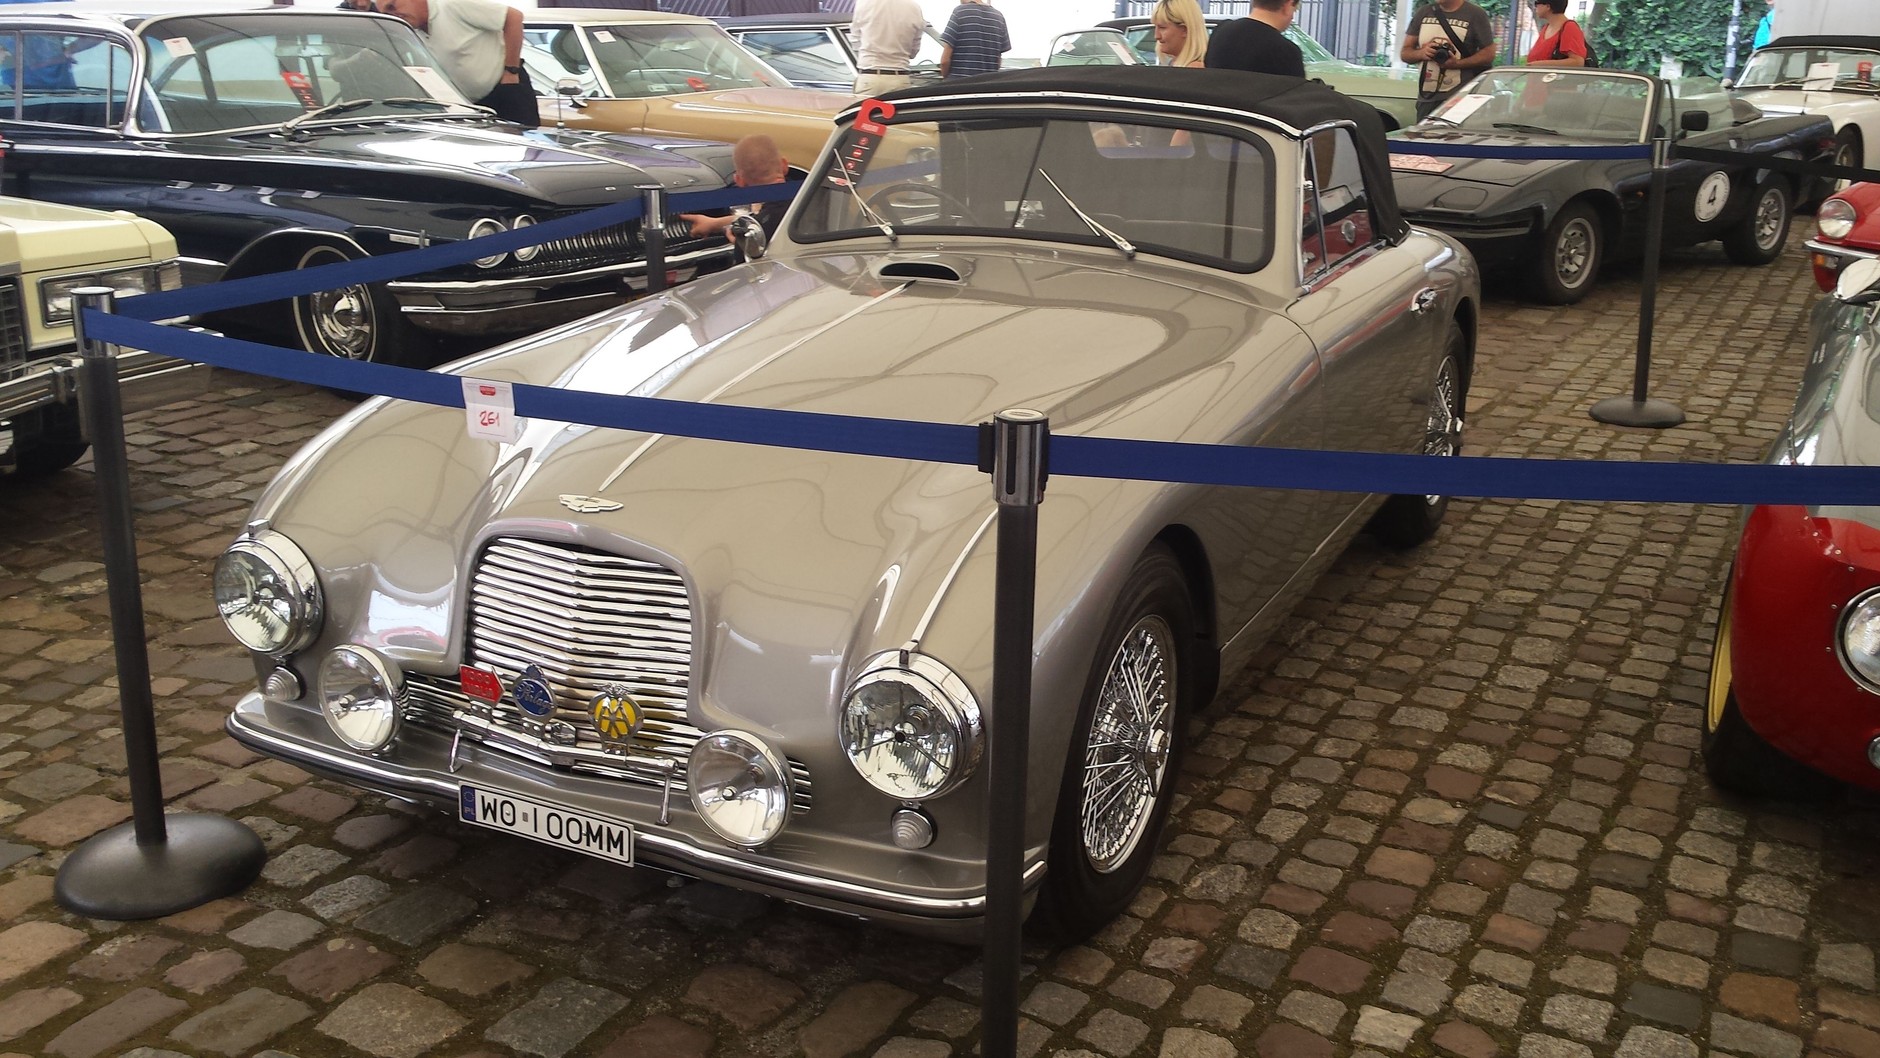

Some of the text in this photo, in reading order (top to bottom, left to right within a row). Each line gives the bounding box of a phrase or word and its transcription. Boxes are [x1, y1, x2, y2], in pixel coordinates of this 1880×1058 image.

[1707, 184, 1718, 206] 4
[479, 410, 500, 428] 261
[464, 806, 476, 817] PL
